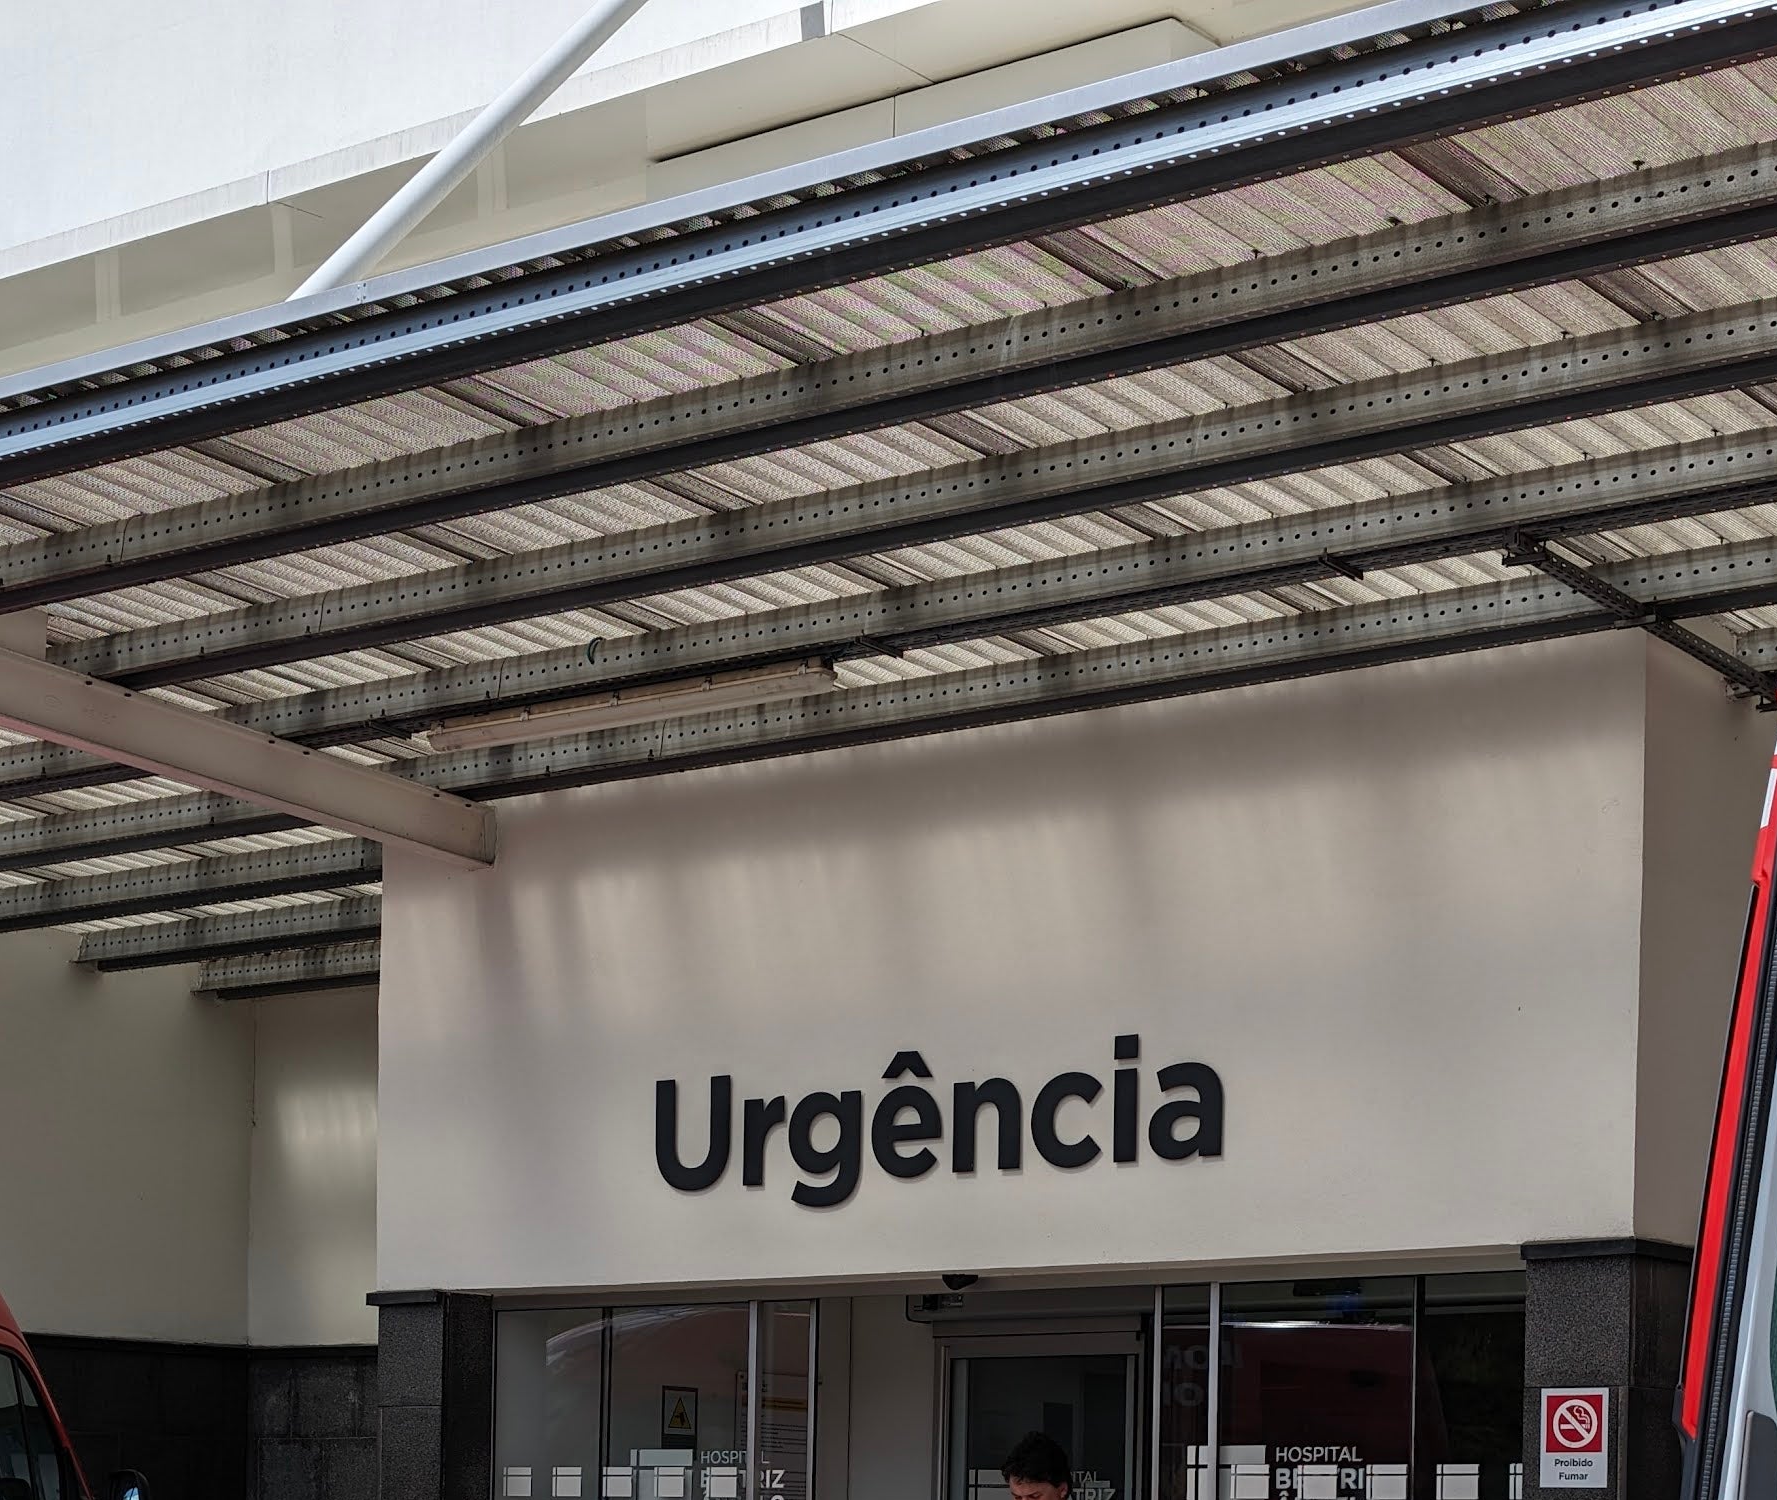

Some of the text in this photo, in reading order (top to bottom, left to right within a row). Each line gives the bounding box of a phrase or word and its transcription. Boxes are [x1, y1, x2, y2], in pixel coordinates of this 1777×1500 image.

[655, 1034, 1224, 1207] Urgência
[1275, 1446, 1363, 1462] HOSPITAL
[1554, 1458, 1593, 1467] Proibido
[1559, 1472, 1588, 1480] Fumar
